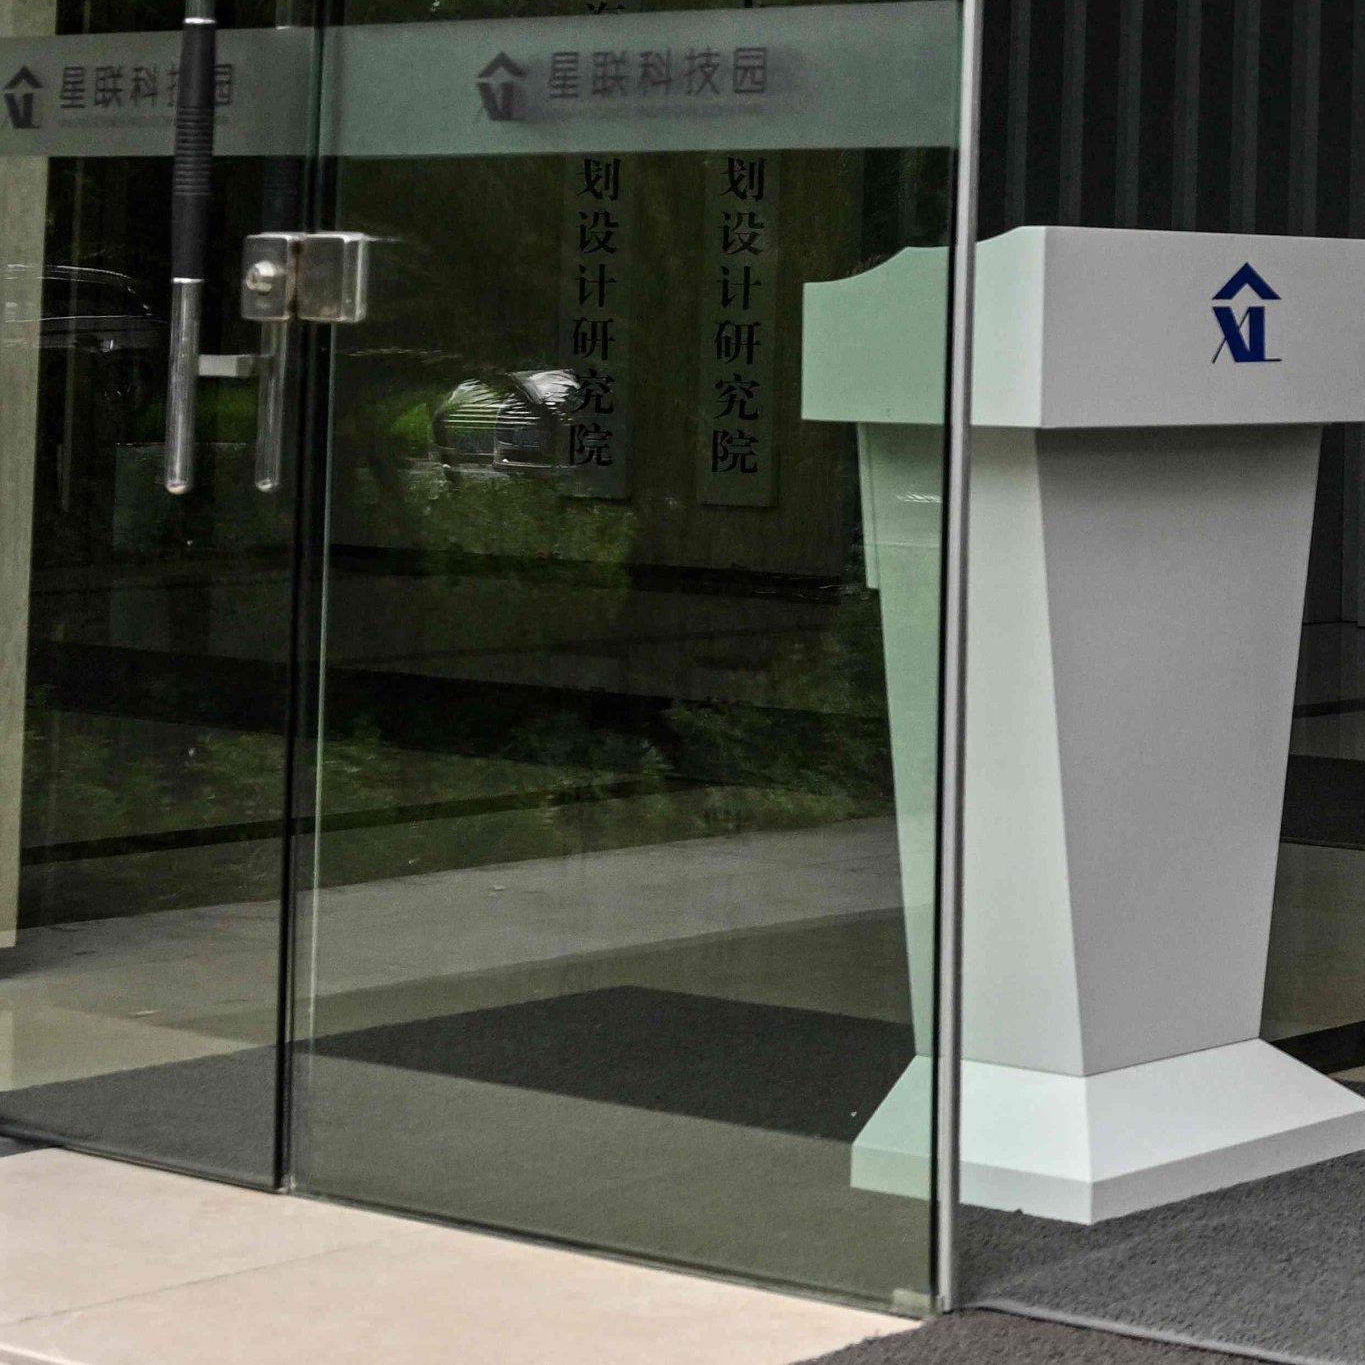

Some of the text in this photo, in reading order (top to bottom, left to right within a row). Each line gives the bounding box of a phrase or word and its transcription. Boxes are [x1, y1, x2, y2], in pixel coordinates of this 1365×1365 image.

[547, 46, 769, 100] 星联科技园
